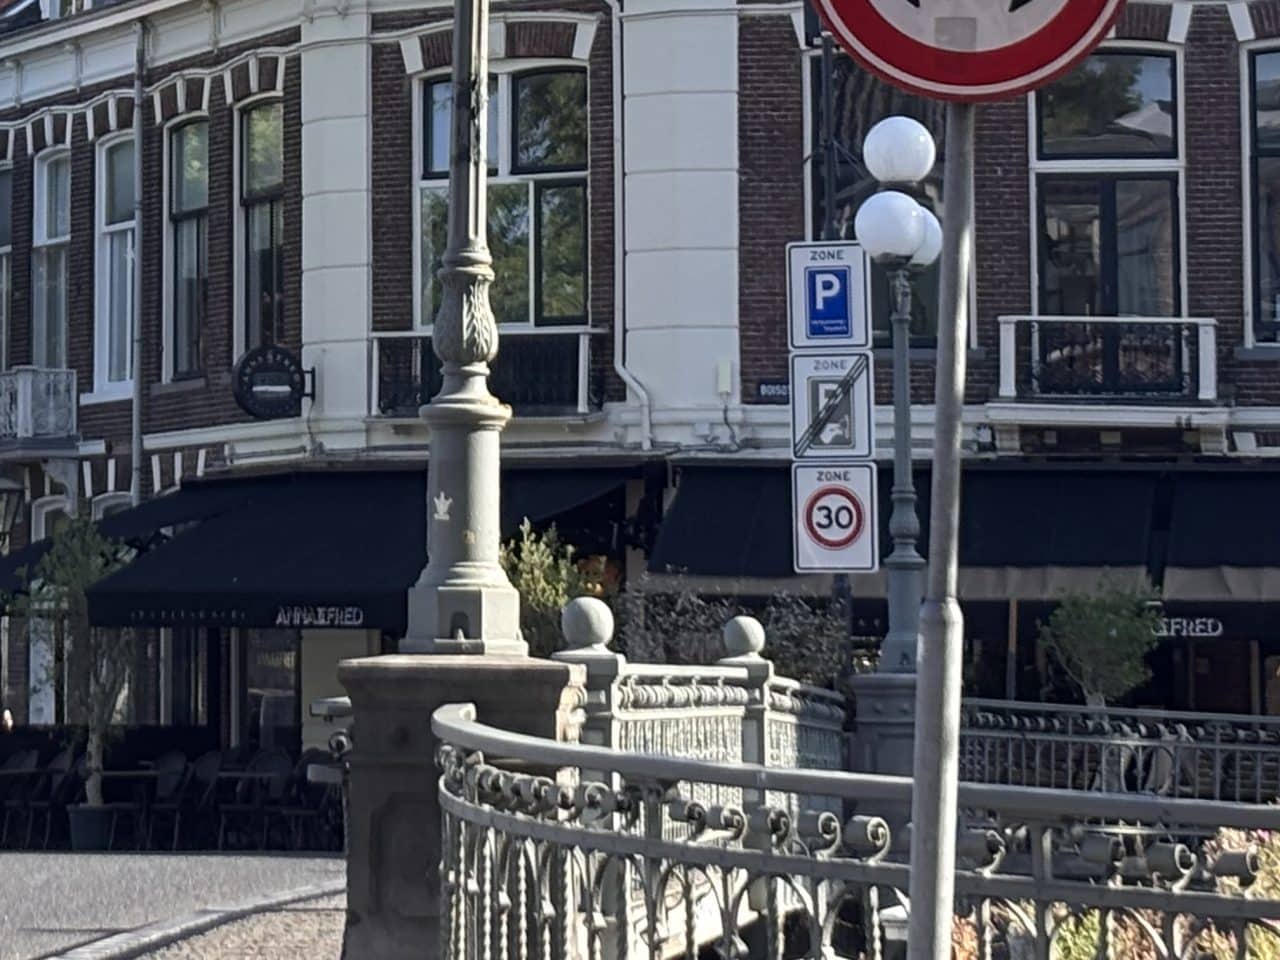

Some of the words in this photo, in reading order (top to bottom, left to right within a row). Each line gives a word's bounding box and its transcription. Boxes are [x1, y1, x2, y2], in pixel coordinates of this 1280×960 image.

[809, 249, 845, 261] ZONE
[815, 273, 841, 310] P
[812, 359, 849, 371] ZONE
[816, 470, 851, 482] ZONE
[815, 505, 854, 530] 30
